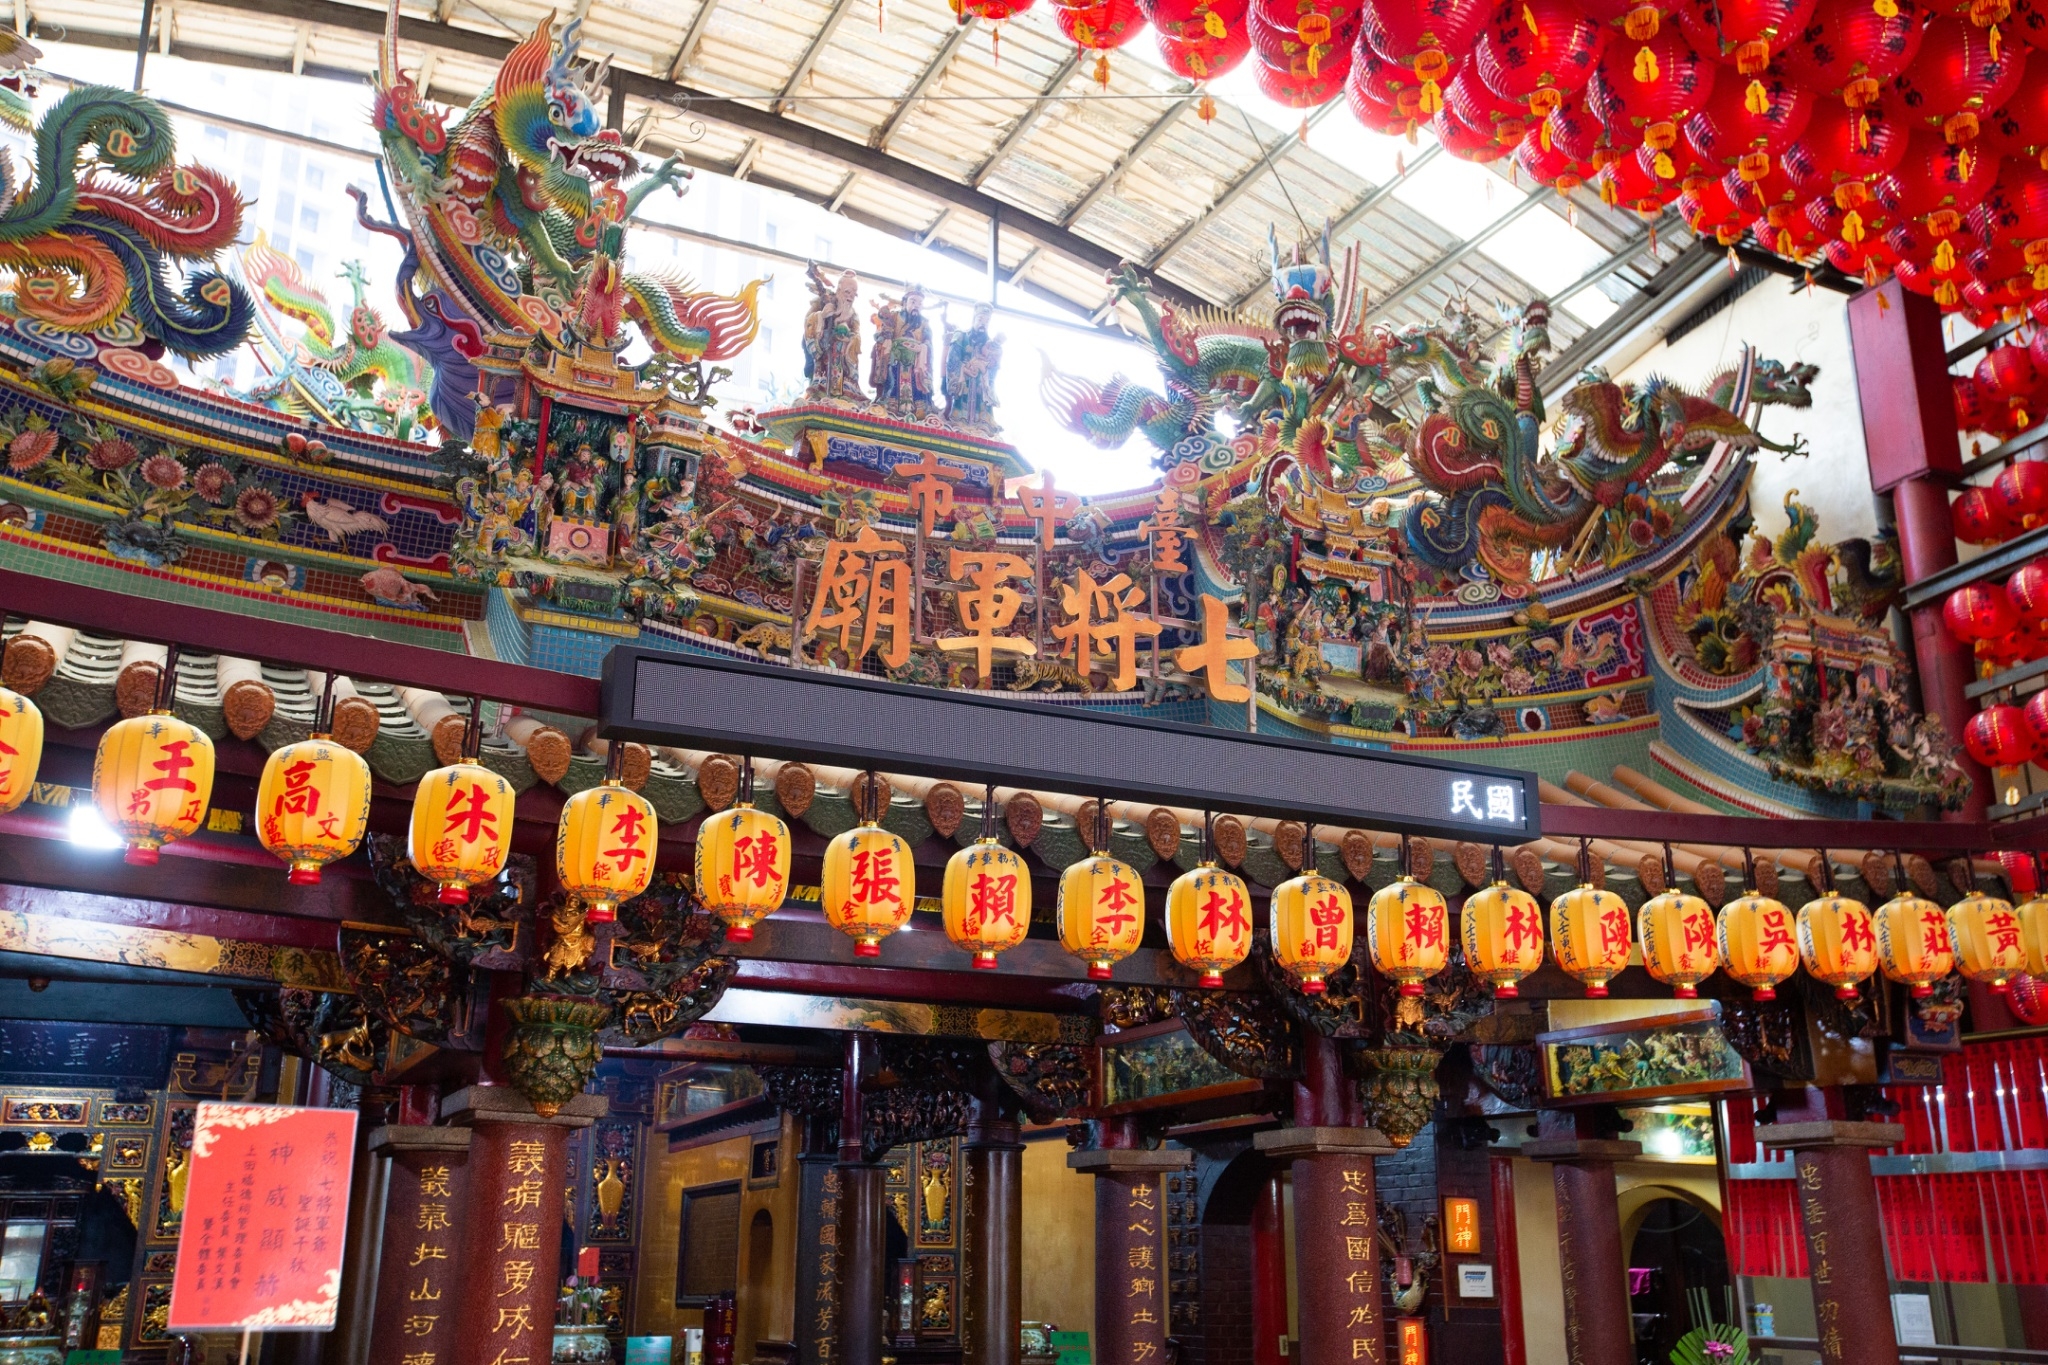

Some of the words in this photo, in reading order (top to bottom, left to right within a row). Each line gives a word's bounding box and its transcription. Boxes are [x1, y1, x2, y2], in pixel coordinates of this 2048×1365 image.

[805, 525, 1261, 704] 七將軍廟
[1451, 780, 1515, 822] 民國
[1197, 888, 1250, 943] 林
